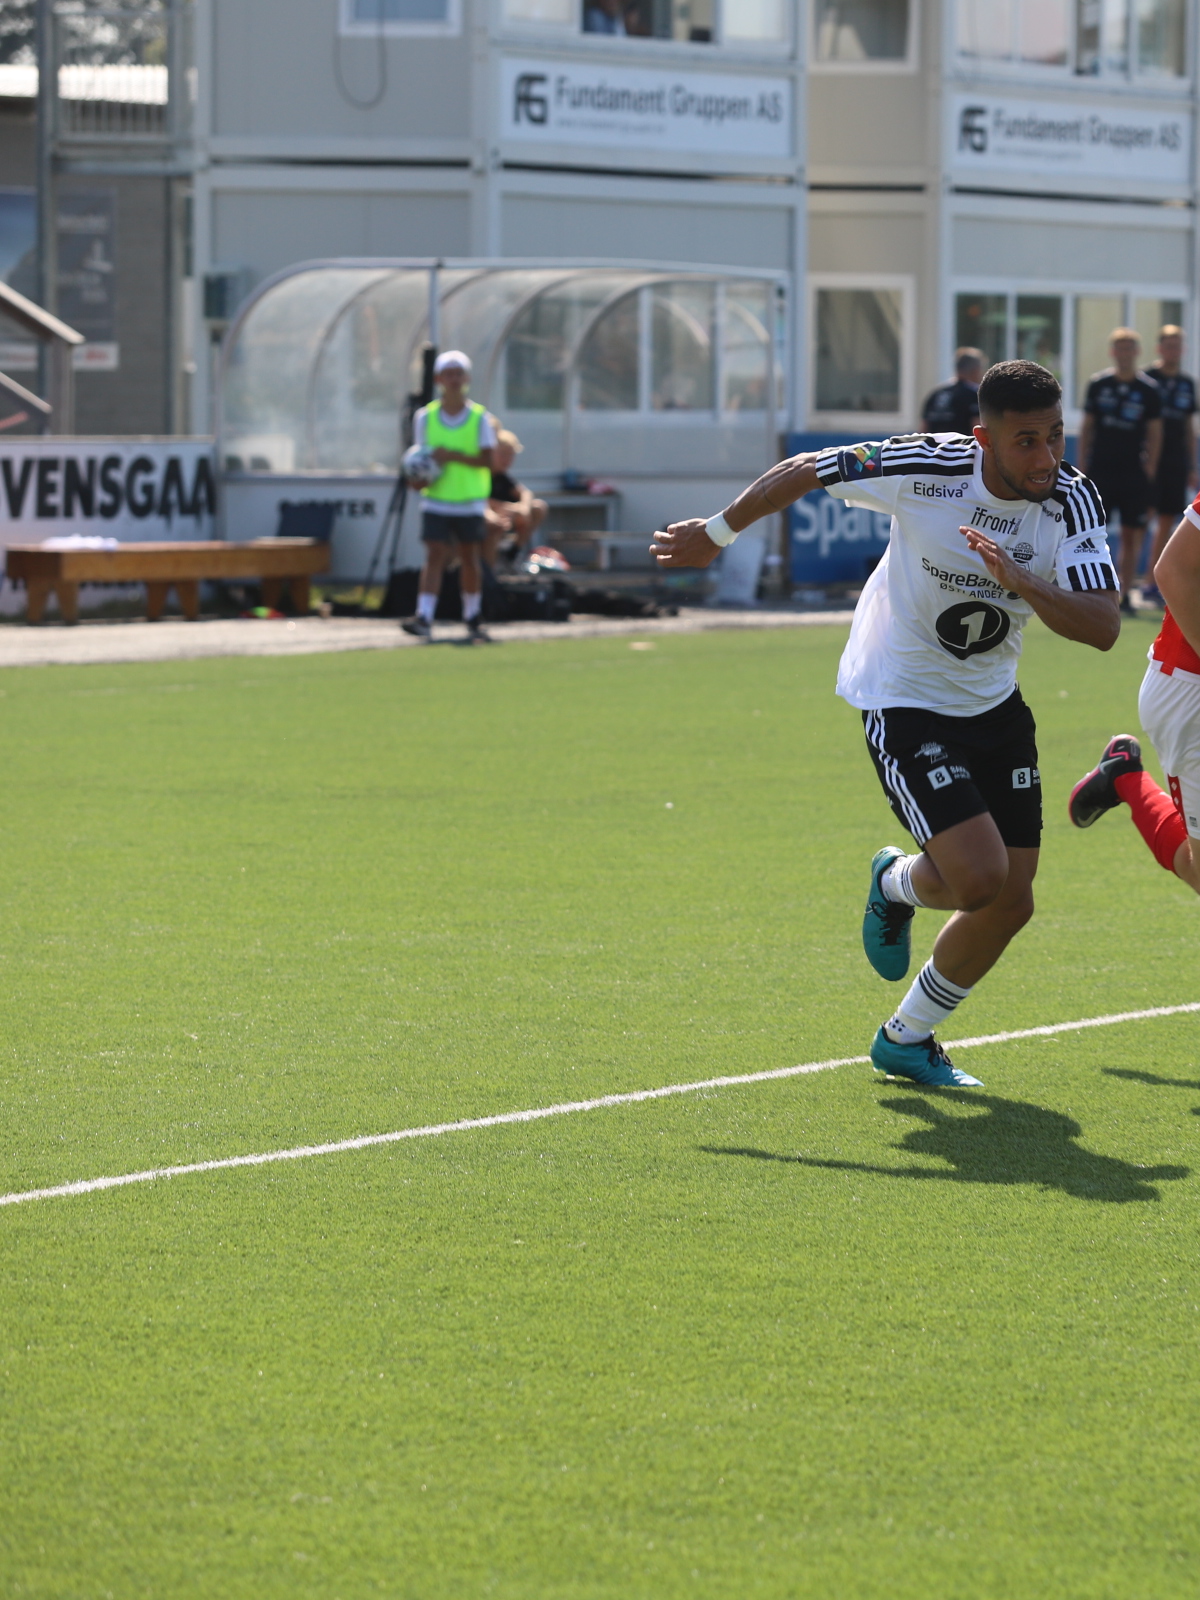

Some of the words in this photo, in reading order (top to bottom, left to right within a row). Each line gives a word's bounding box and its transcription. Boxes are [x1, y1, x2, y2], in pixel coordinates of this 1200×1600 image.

[556, 75, 666, 115] Fundament
[672, 84, 750, 125] Gruppen
[757, 89, 784, 123] AS
[994, 108, 1082, 143] Fundament
[1089, 114, 1154, 150] Gruppen
[1158, 121, 1182, 150] AS
[913, 481, 964, 498] Eidsiva
[971, 506, 1016, 535] iFront
[922, 557, 1005, 592] SpareBank
[940, 583, 1005, 599] ØSTANDET
[960, 611, 986, 649] 1
